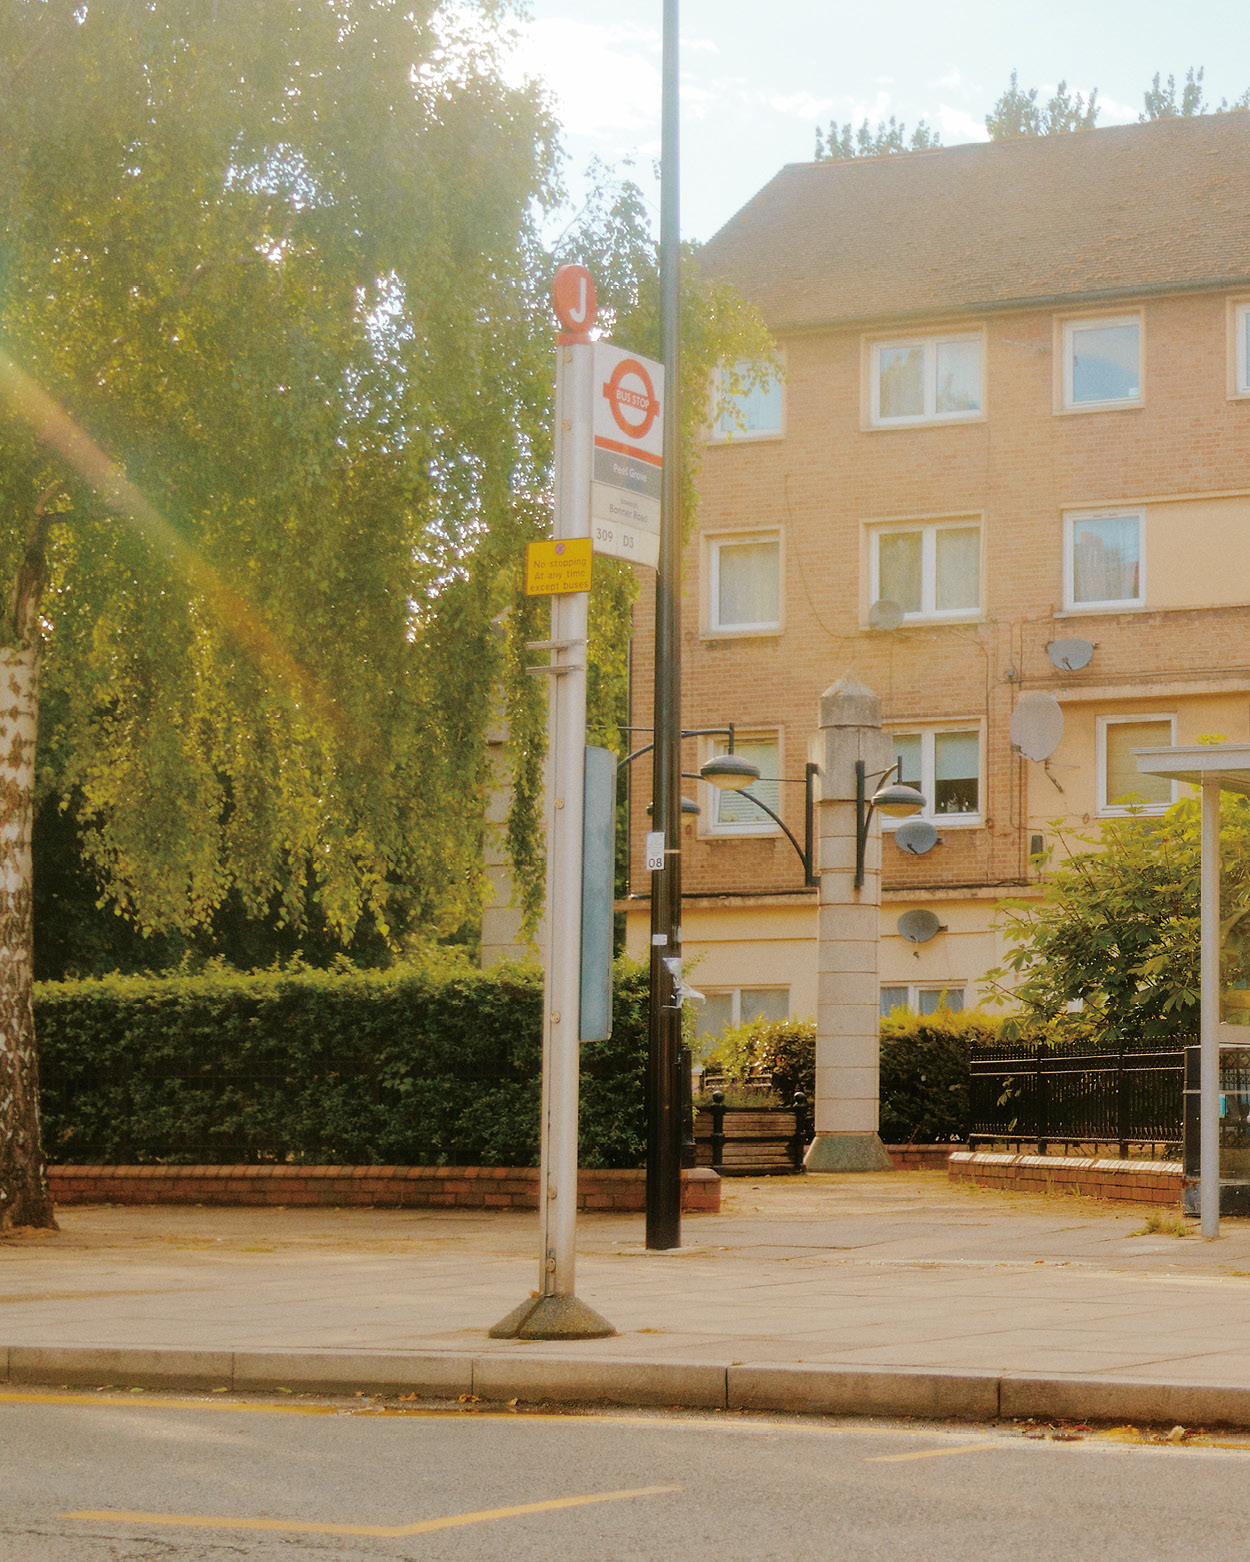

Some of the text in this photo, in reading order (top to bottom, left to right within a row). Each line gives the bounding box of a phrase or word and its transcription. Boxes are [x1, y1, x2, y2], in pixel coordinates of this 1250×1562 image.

[569, 276, 586, 323] J
[616, 389, 650, 409] BUS STOP
[613, 463, 647, 482] Peel Grove
[633, 511, 648, 523] Road
[596, 528, 634, 548] 309 D3
[534, 558, 587, 568] No stopping
[535, 569, 585, 580] At any time
[530, 581, 589, 592] except buses
[648, 857, 662, 868] 08
